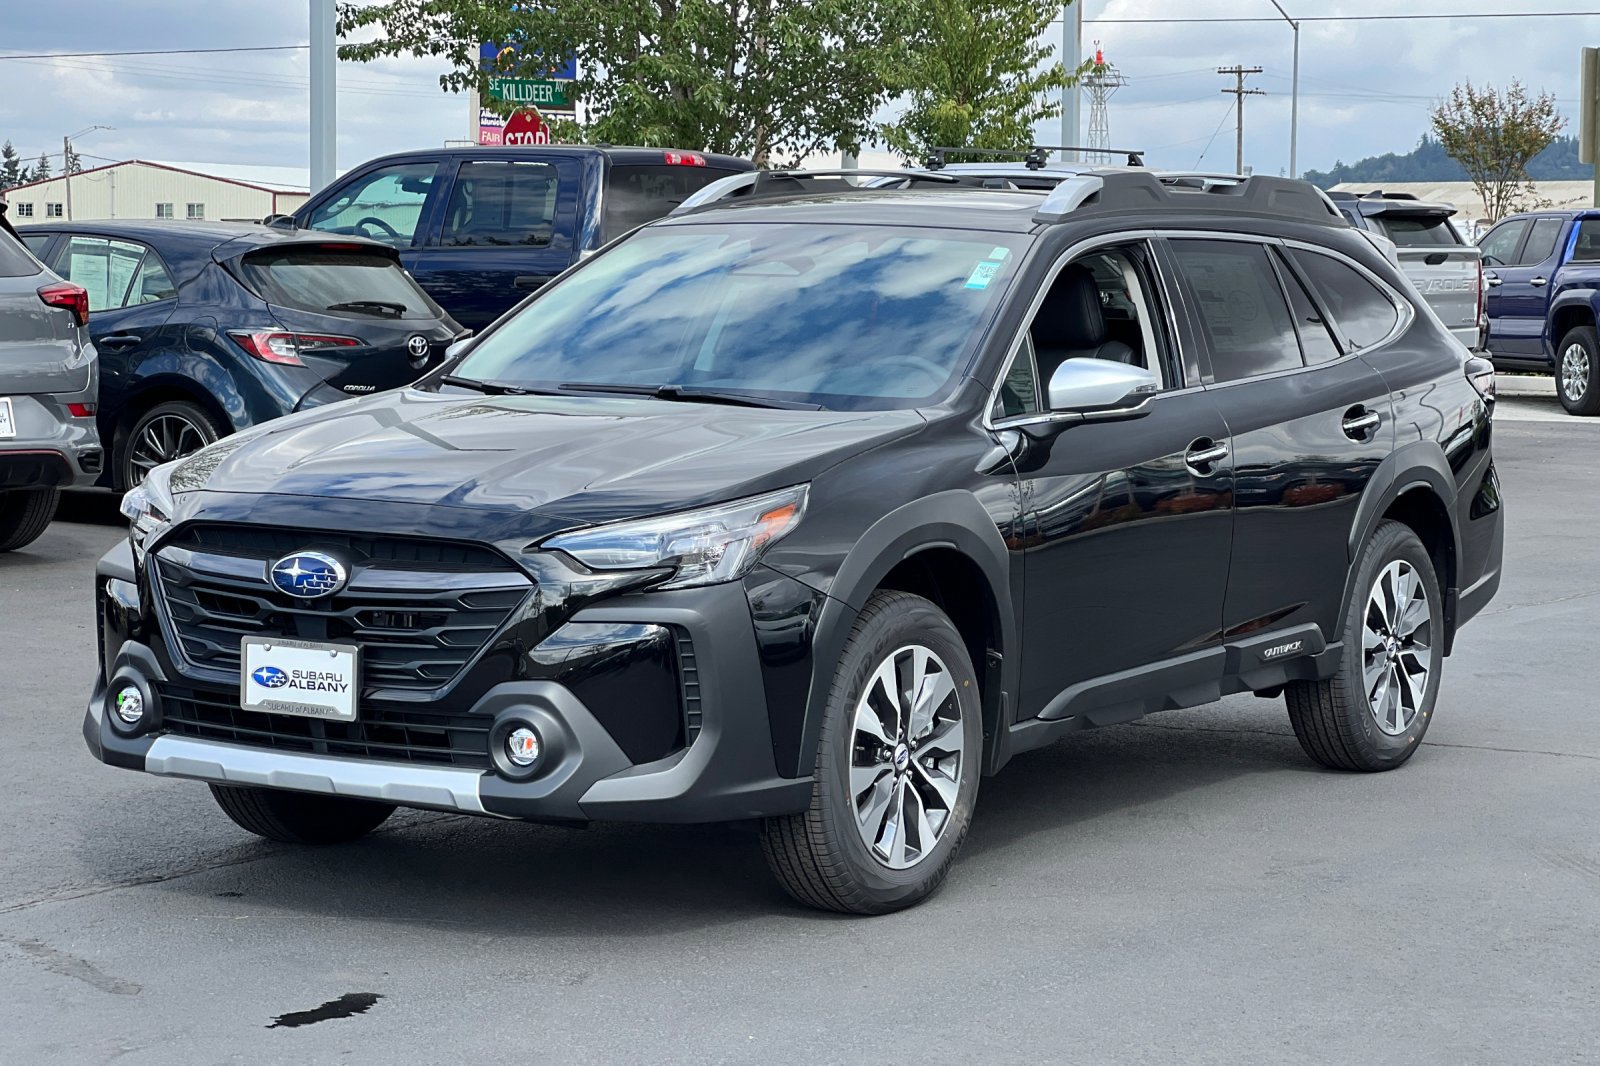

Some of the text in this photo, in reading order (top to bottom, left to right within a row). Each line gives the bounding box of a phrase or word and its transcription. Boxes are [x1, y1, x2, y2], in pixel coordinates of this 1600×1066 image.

[488, 79, 567, 102] SE KILLDEER AV
[481, 131, 501, 143] FAIR
[343, 384, 376, 392] COROLLA
[1264, 640, 1302, 657] OUTBACK
[292, 669, 343, 682] SUBARU
[288, 680, 349, 693] ALBANY
[922, 816, 971, 891] YOKOHAMA
